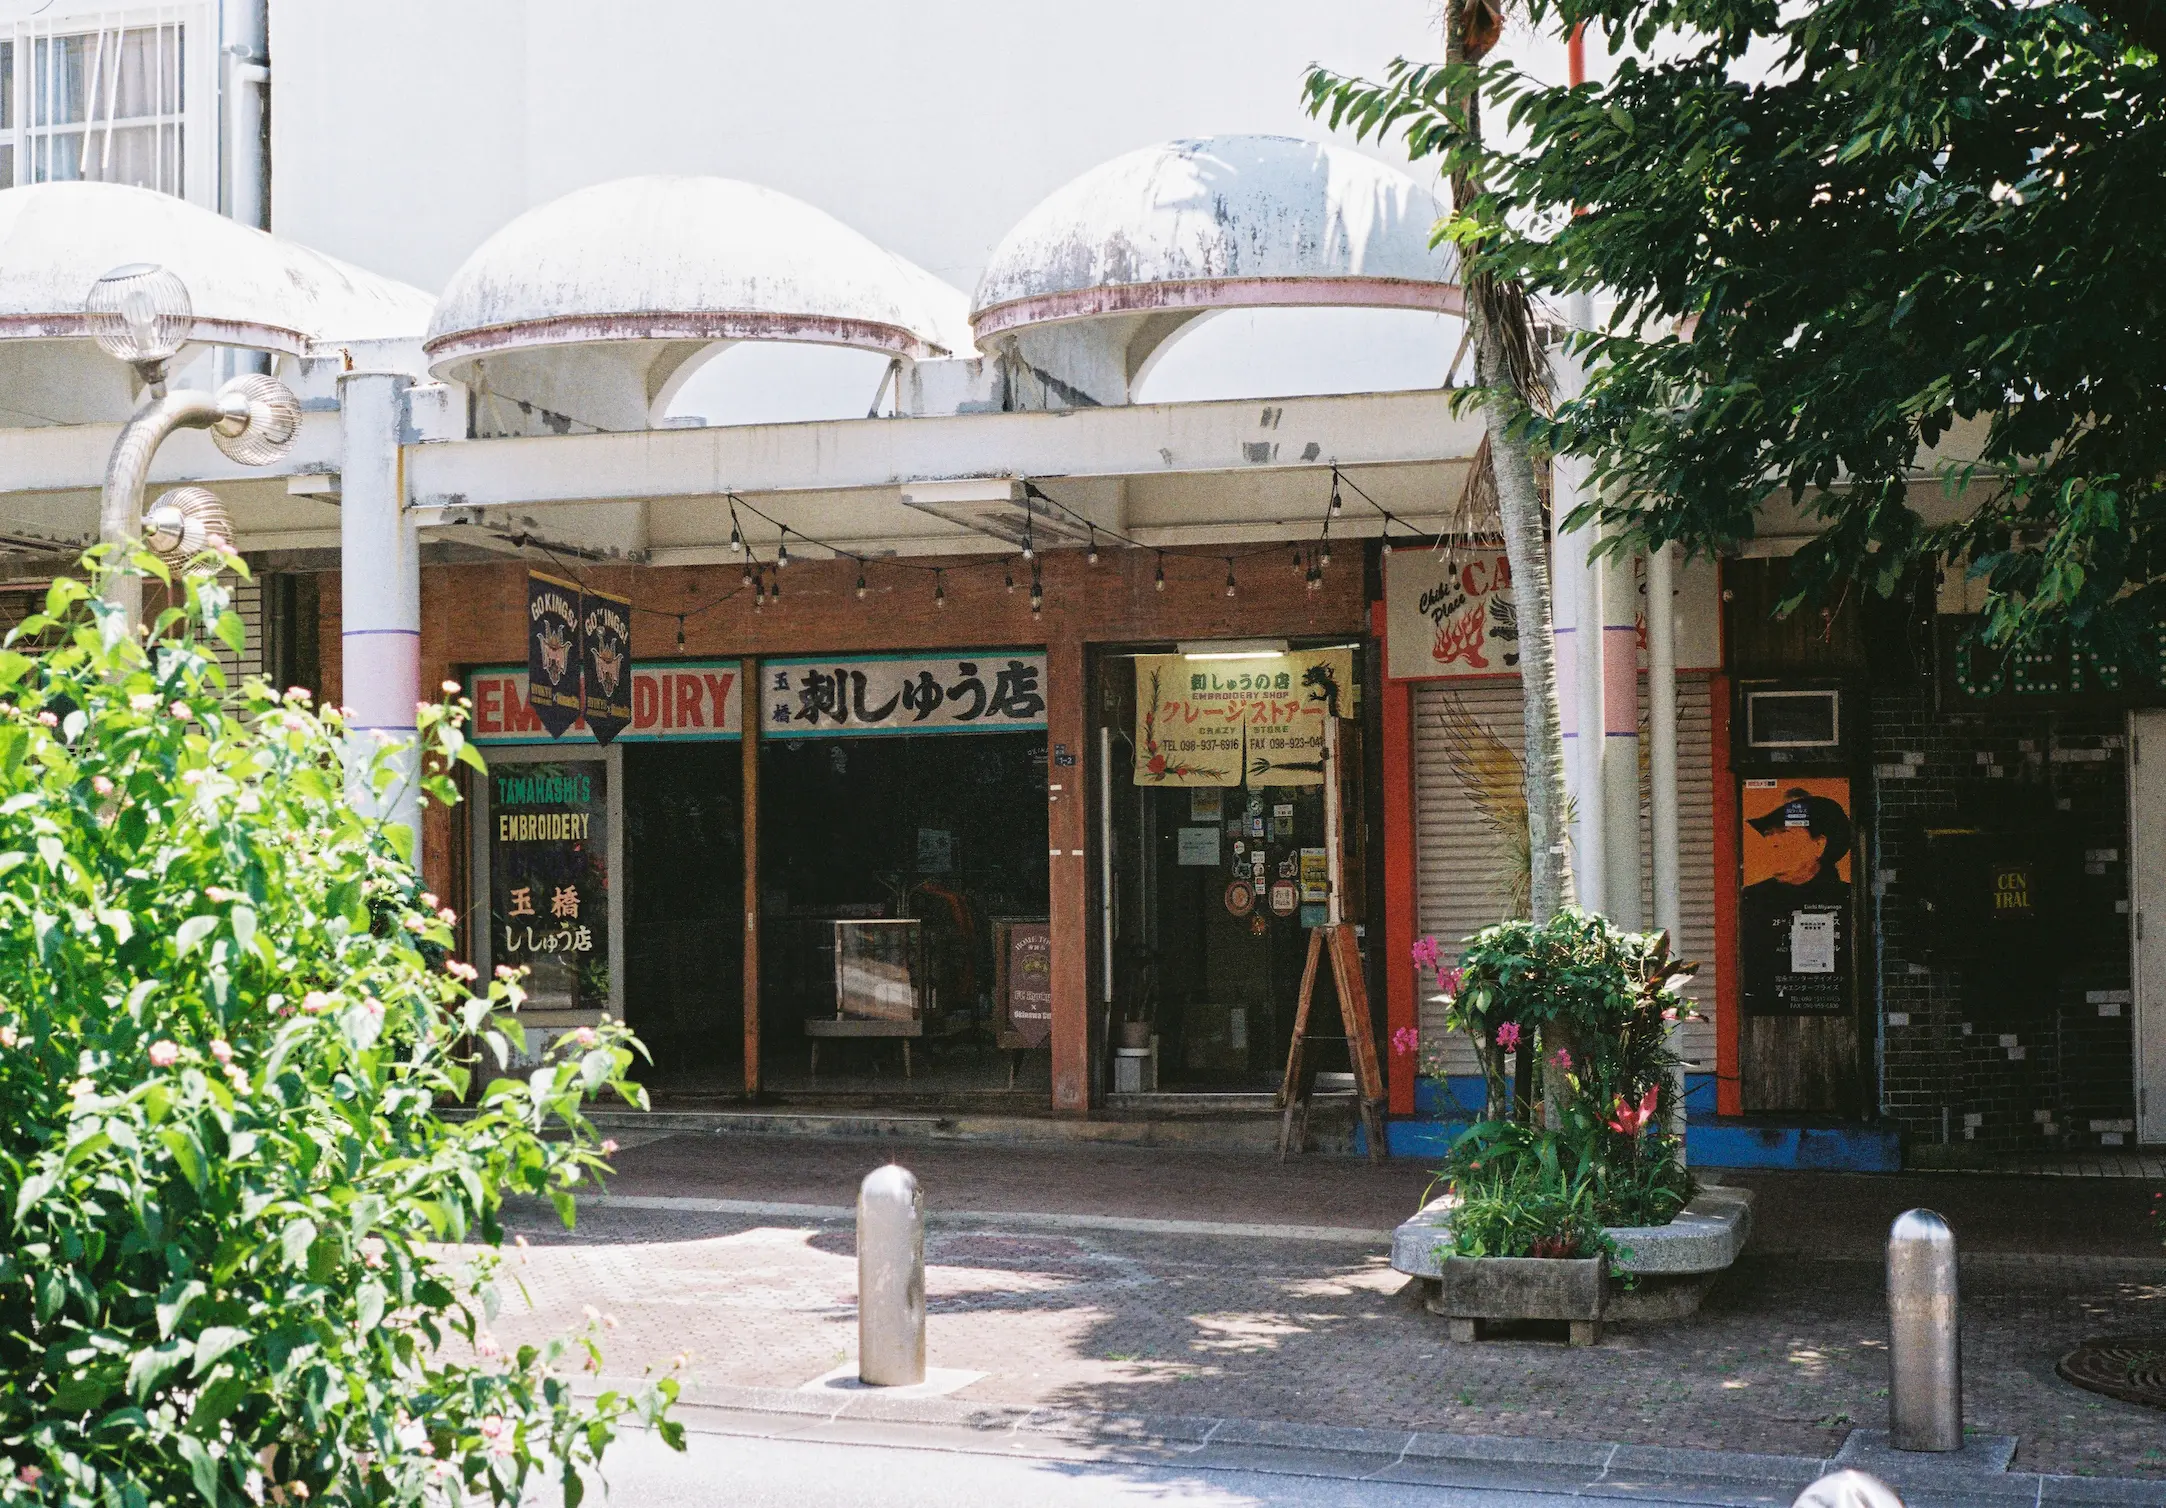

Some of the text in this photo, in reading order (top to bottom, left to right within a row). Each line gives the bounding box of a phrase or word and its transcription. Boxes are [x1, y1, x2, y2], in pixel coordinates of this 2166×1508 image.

[1461, 556, 1513, 597] CA
[1419, 581, 1460, 615] Chibi
[1430, 593, 1466, 627] Place
[477, 673, 735, 733] EMDIRY
[1192, 691, 1290, 700] EMBROIDERY SHOP
[1162, 739, 1178, 752] TEL
[1180, 738, 1240, 752] 098-937-6916
[1249, 739, 1266, 750] FAX
[1198, 725, 1290, 735] CRAZY STORE
[498, 773, 591, 804] TAMAHASHI'S
[499, 812, 590, 842] EMBROIDERY
[1997, 872, 2028, 890] CEN
[1993, 891, 2032, 909] TRAL
[505, 923, 593, 954] ししゅう店
